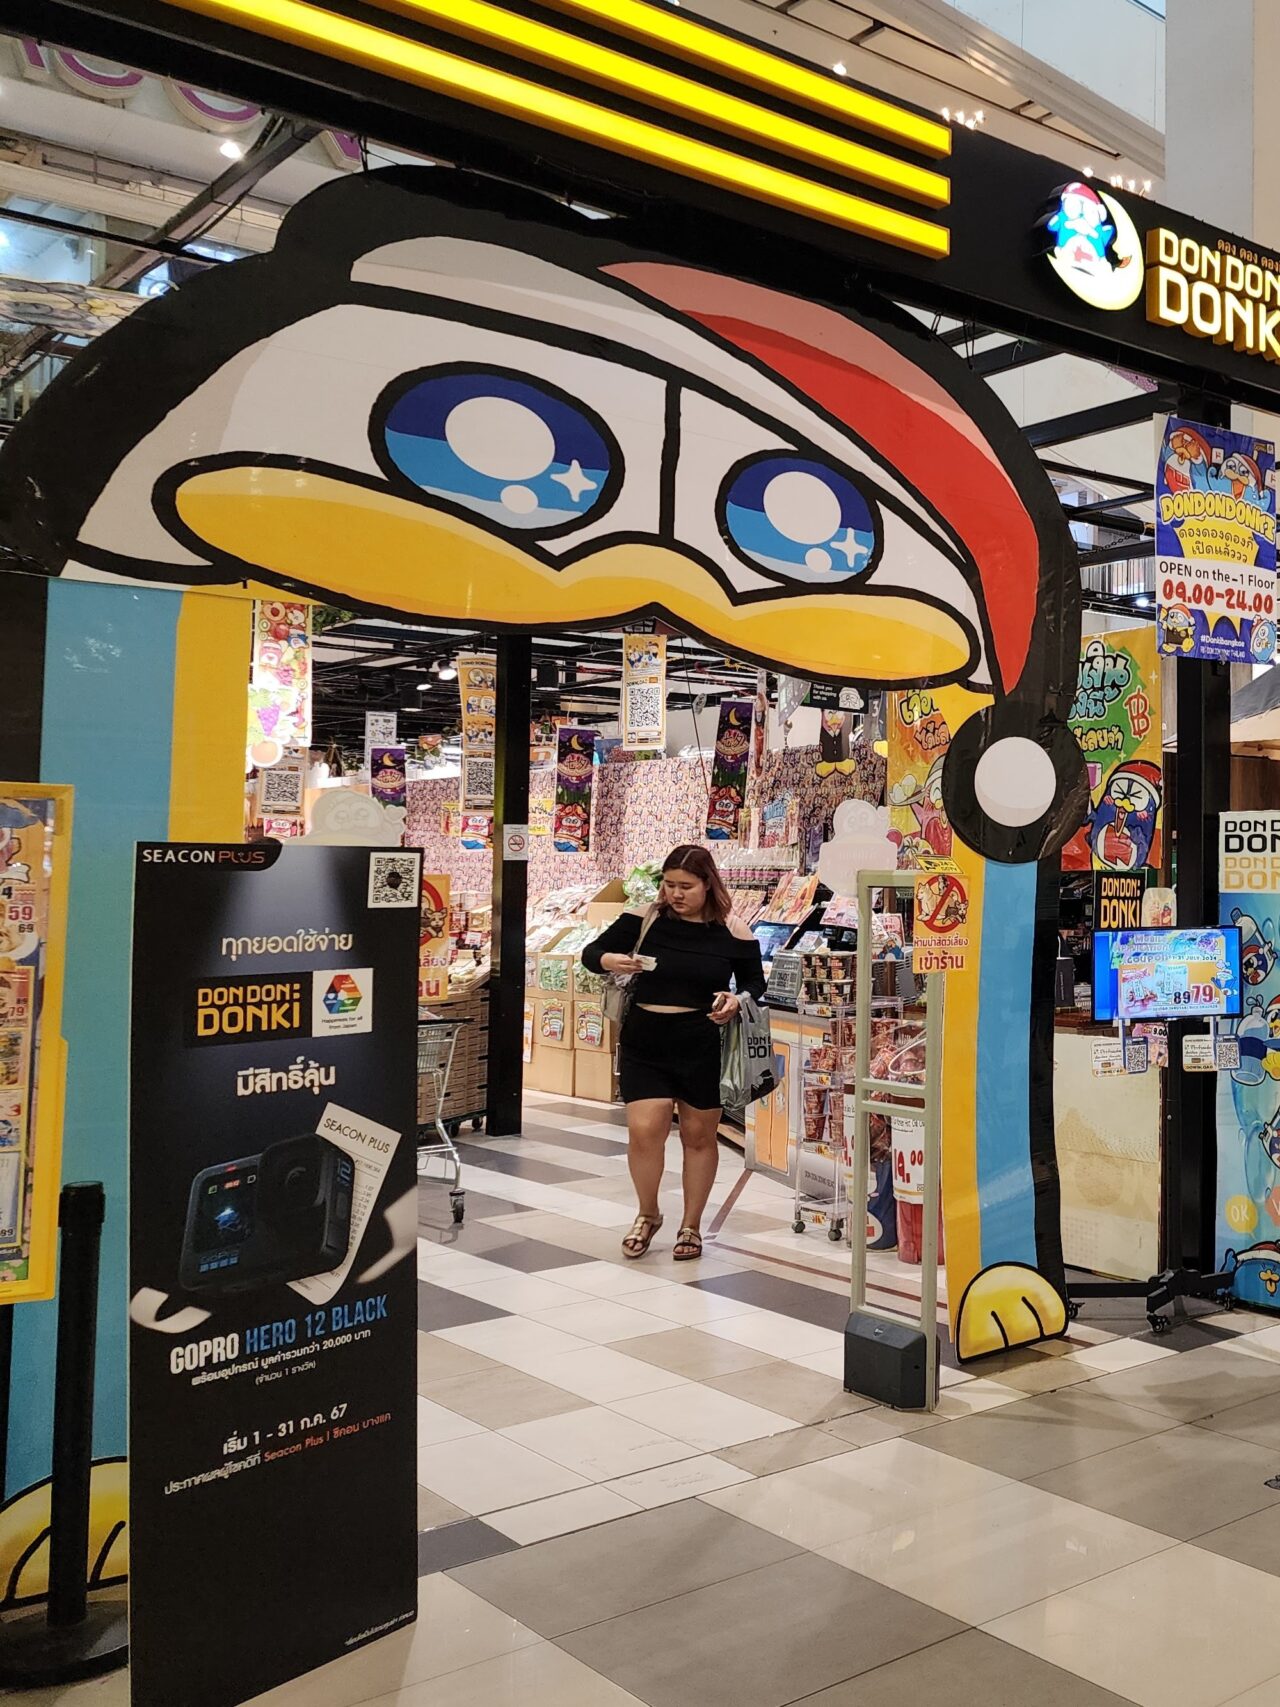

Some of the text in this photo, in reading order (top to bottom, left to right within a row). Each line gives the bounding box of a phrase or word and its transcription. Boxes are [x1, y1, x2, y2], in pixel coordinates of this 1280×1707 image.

[1150, 227, 1221, 284] DON
[1159, 561, 1192, 579] OPEN
[1195, 567, 1209, 579] on
[1212, 567, 1230, 583] the
[1248, 574, 1275, 590] Floor
[1224, 820, 1267, 833] DON
[142, 848, 215, 863] SEACON
[1224, 857, 1267, 869] DON
[1101, 877, 1119, 897] DON
[8, 906, 33, 921] 59
[1100, 899, 1141, 929] DONKI
[221, 928, 353, 961] ทุกยอดใช้จ่าย
[919, 950, 965, 971] เข้าร้าน
[198, 986, 243, 1006] DON
[1173, 991, 1191, 1005] 89
[197, 1003, 300, 1037] DONKI
[237, 1056, 337, 1097] มีสิทธิ์ลุ้น
[323, 1118, 391, 1155] SEACON PLUS
[1231, 1204, 1249, 1223] OK
[170, 1294, 388, 1375] GOPRO HERO 12 BLACK
[322, 1333, 352, 1351] 20,000
[355, 1329, 371, 1343] บาท
[223, 1430, 247, 1455] เริ่ม
[278, 1419, 294, 1436] 31
[300, 1412, 326, 1429] ก.ค.
[330, 1402, 348, 1421] 67
[264, 1441, 302, 1464] Seacon
[305, 1432, 325, 1450] Plus
